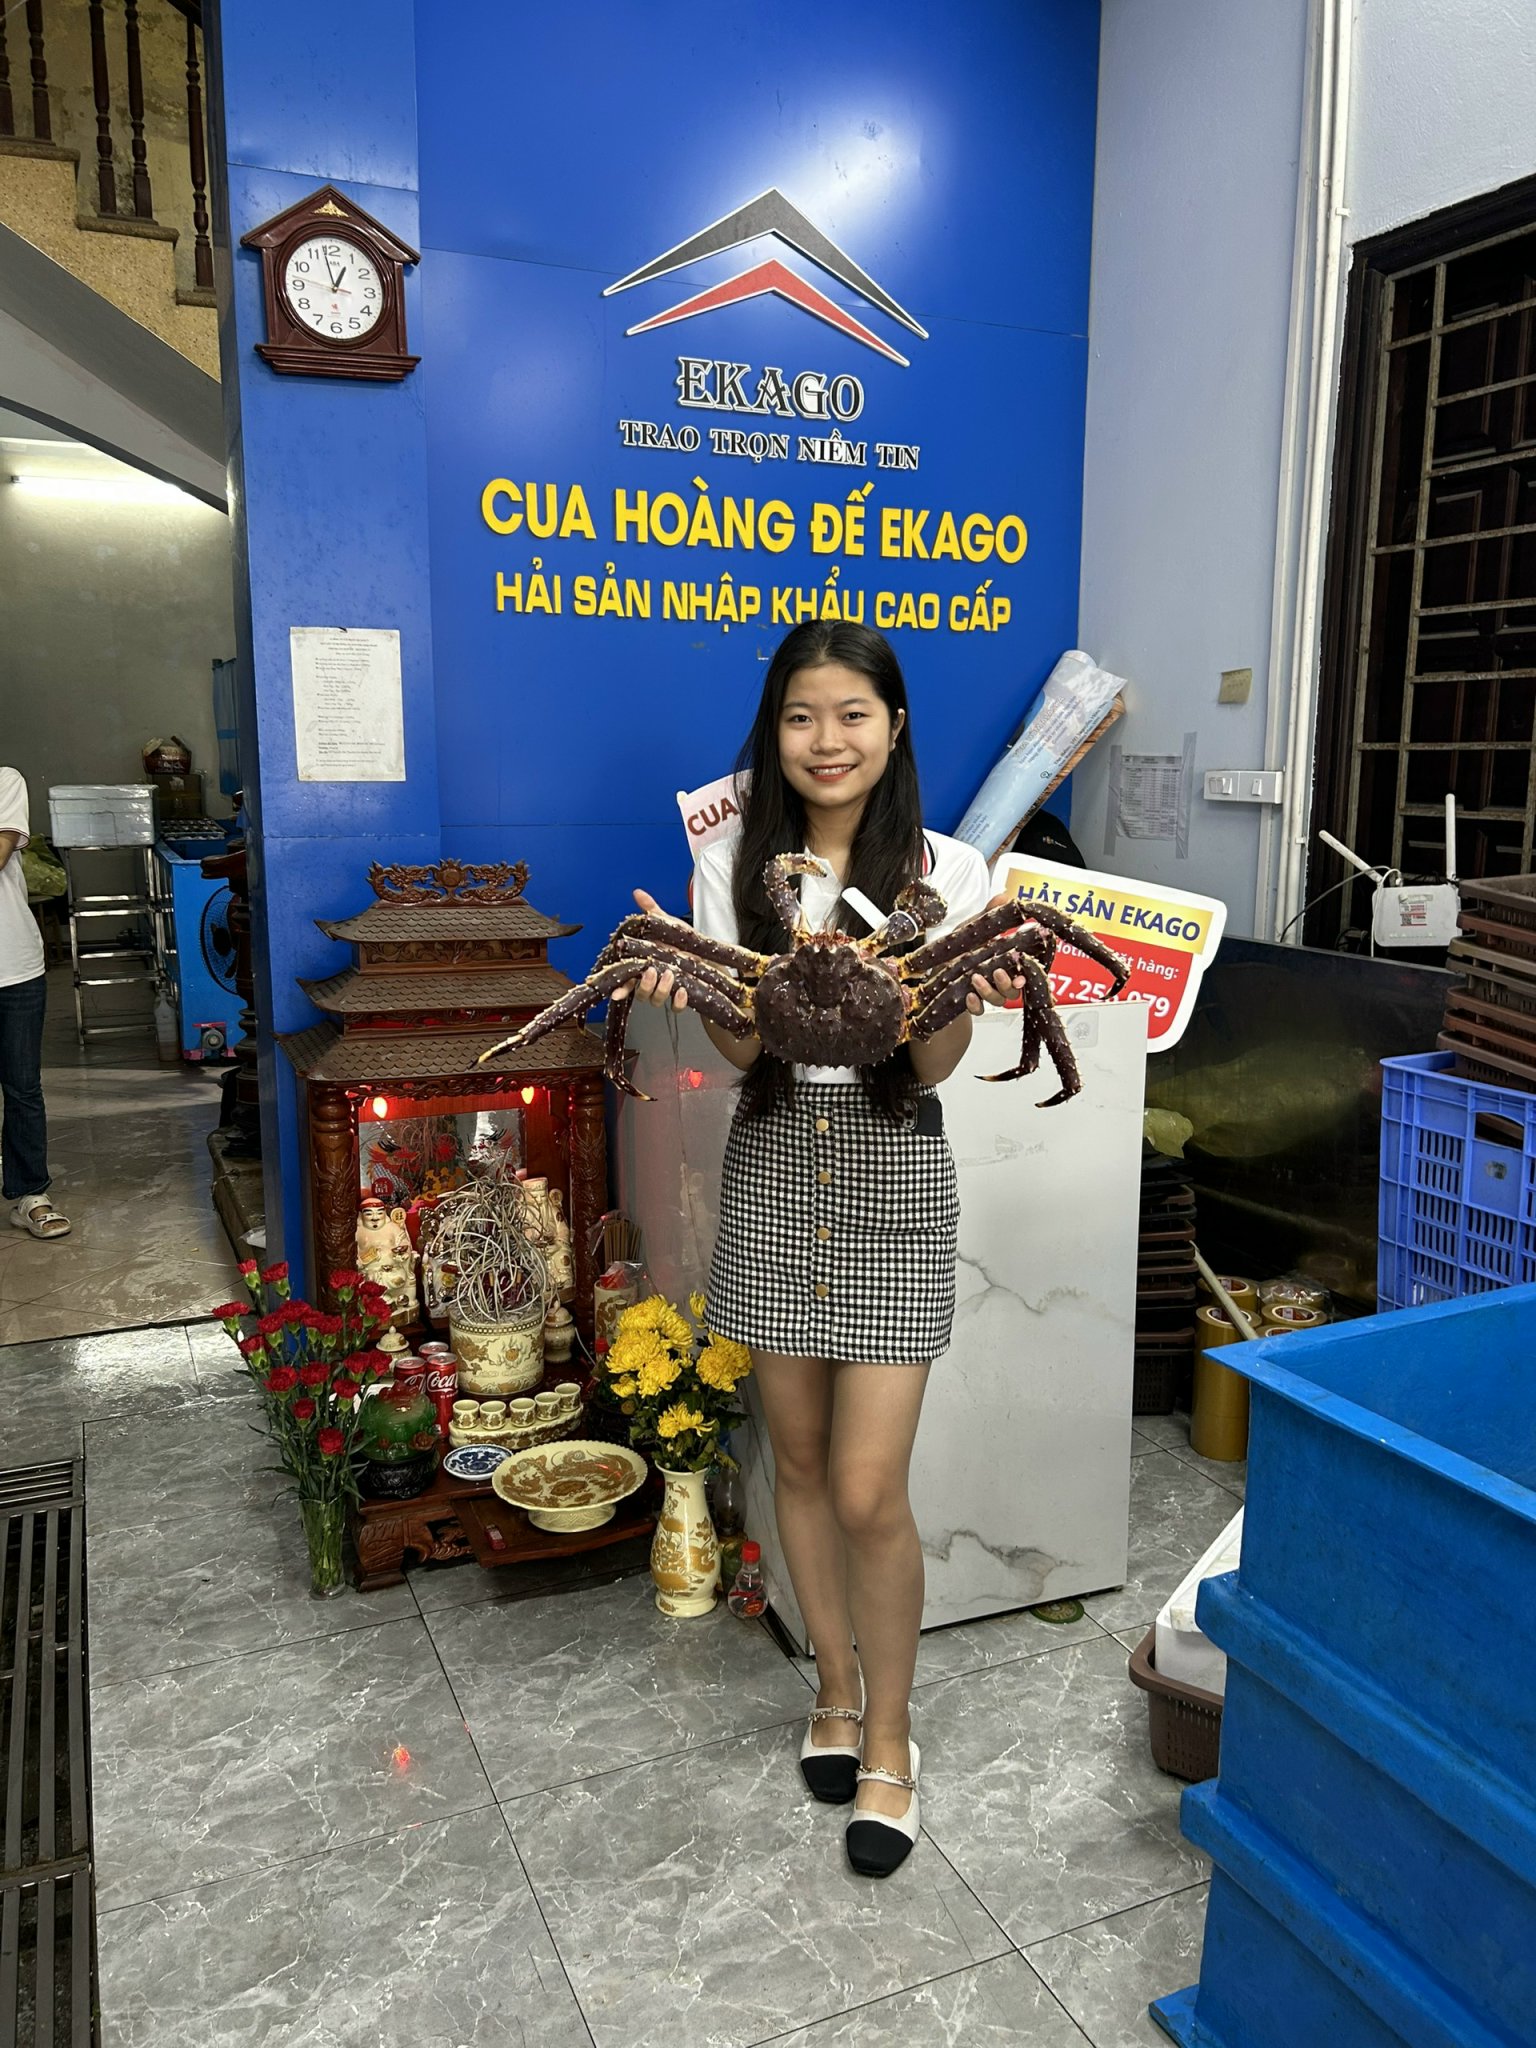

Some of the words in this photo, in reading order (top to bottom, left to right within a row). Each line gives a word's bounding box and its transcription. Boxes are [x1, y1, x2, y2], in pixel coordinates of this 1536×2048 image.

[308, 248, 319, 260] 11
[349, 253, 354, 264] 1
[295, 261, 310, 273] 10
[358, 268, 370, 280] 2
[292, 280, 305, 291] 9
[364, 288, 376, 299] 3
[298, 298, 310, 309] 8
[360, 305, 372, 316] 4
[313, 313, 323, 326] 7
[348, 317, 361, 329] 5
[330, 322, 343, 334] 6
[676, 356, 865, 422] EKAGO
[620, 419, 701, 452] TRAO
[710, 428, 790, 463] TRỌN
[798, 428, 867, 467] NIỀM
[875, 442, 920, 470] TIN
[482, 479, 597, 540] CUA
[615, 477, 795, 553] HOÀNG
[810, 482, 874, 556] ĐẾ
[881, 507, 1028, 564] EKAGO
[496, 556, 562, 614] HẢI
[574, 561, 651, 619] SẢN
[663, 573, 761, 633] NHẬP
[772, 565, 865, 624] KHẨU
[875, 591, 940, 630] CAO
[949, 579, 1011, 632] CẤP
[687, 797, 740, 836] CUA
[1017, 882, 1062, 907] HẢI
[1064, 889, 1116, 921] SẢN
[1119, 904, 1201, 942] EKAGO
[1136, 956, 1180, 980] hàng:
[427, 1371, 456, 1393] Coca
